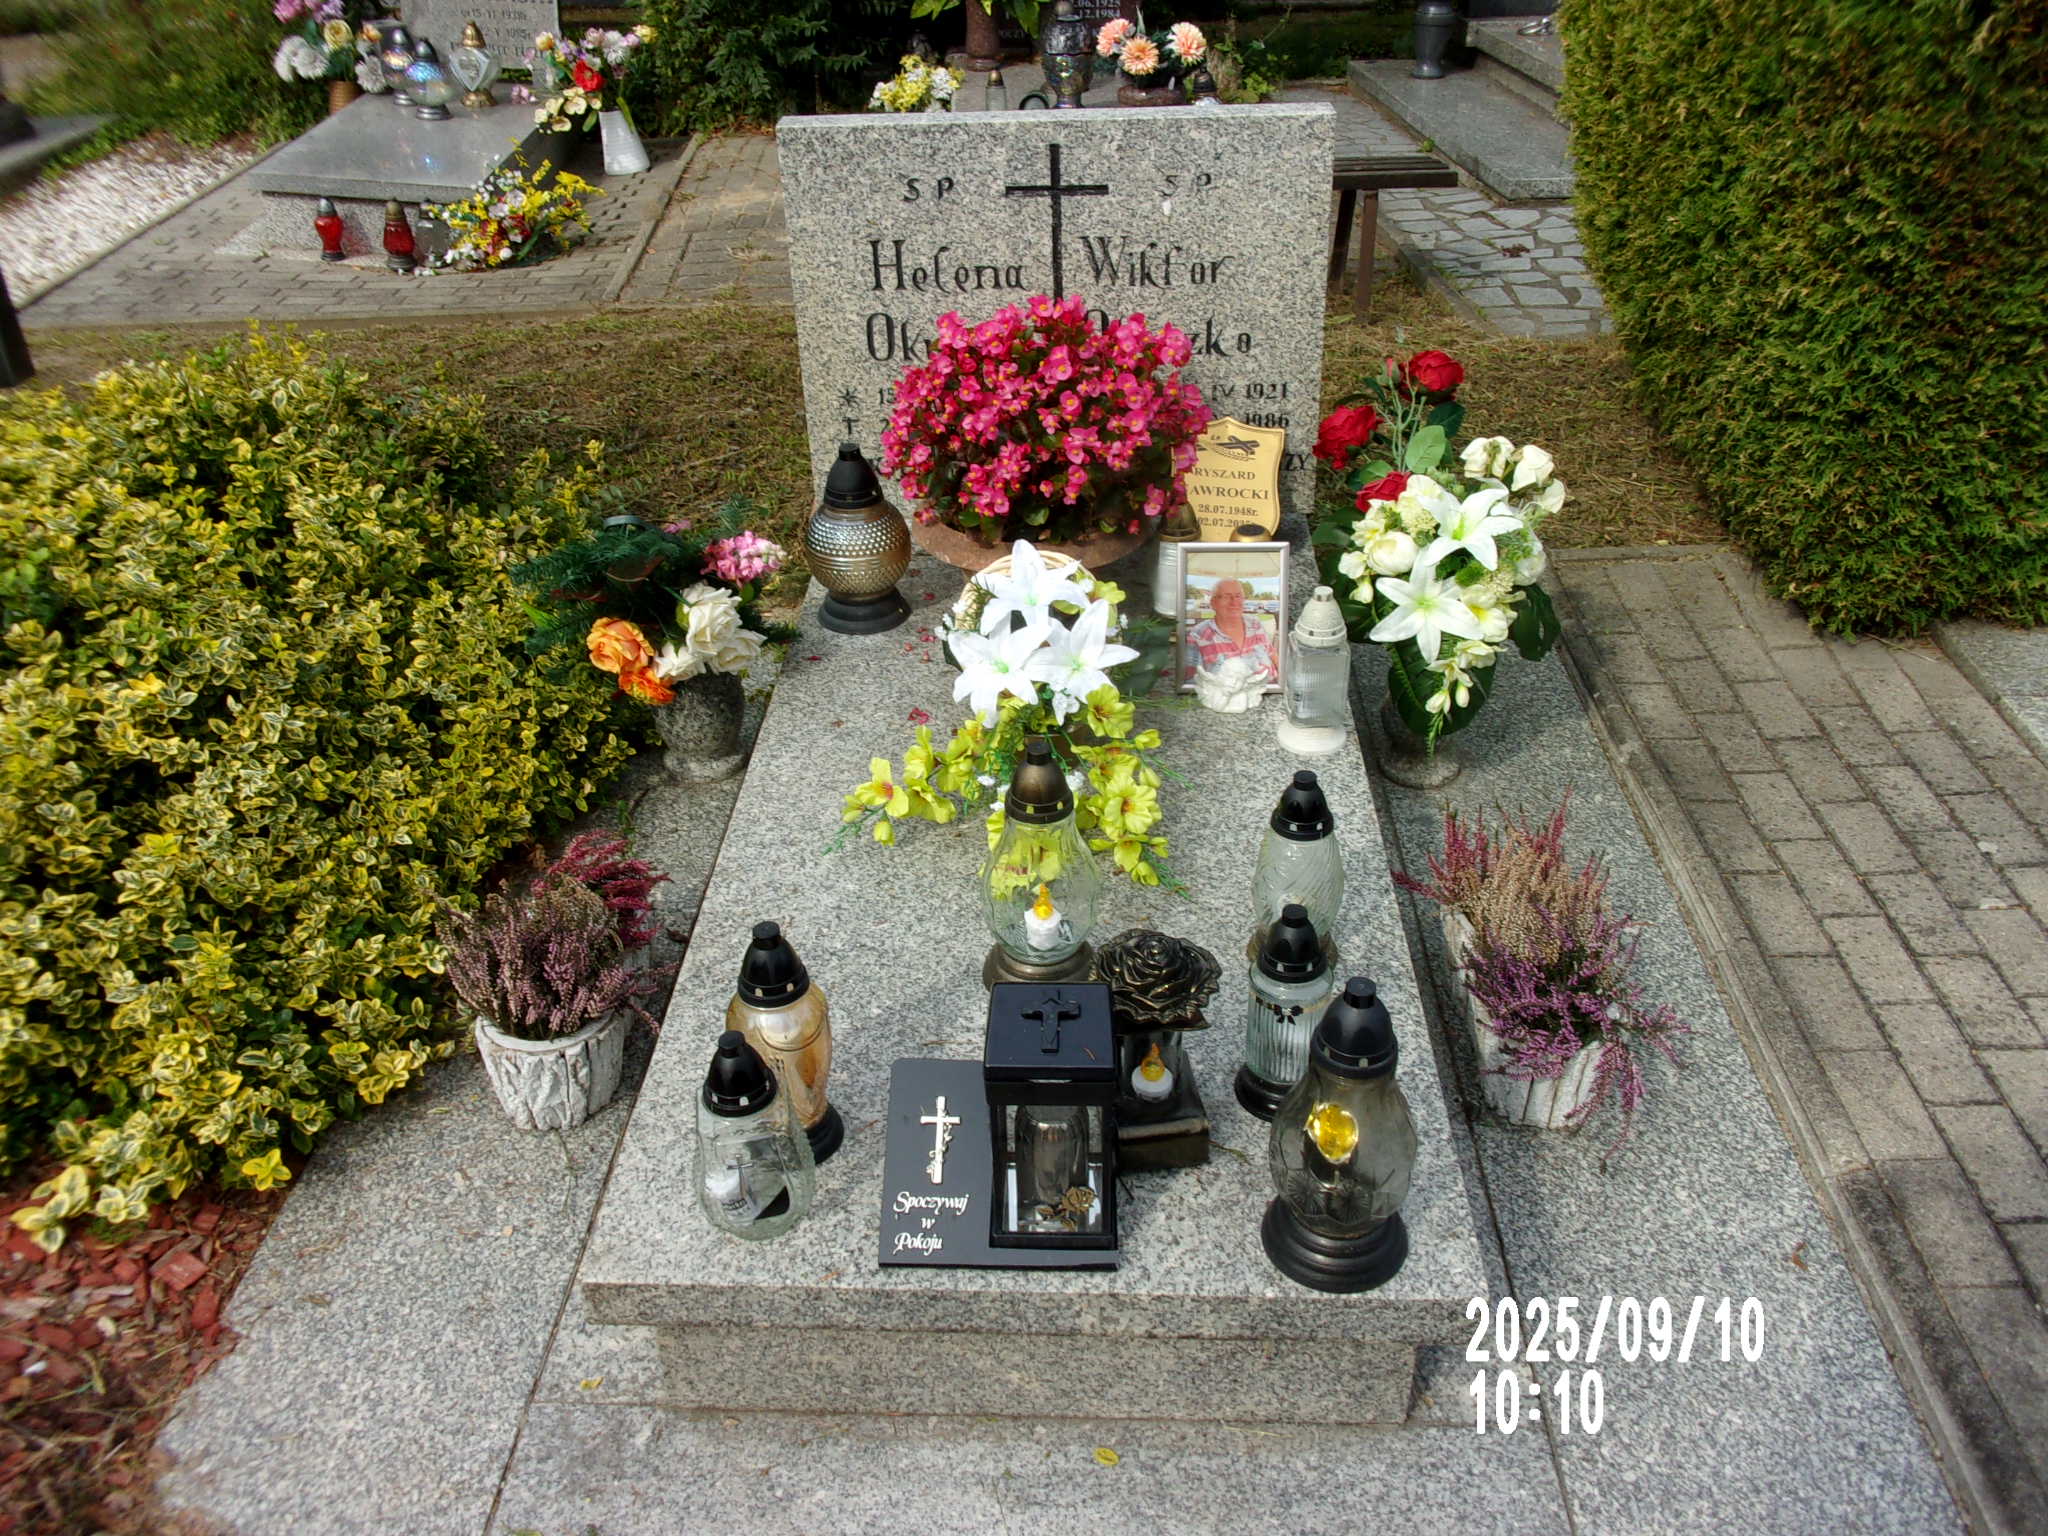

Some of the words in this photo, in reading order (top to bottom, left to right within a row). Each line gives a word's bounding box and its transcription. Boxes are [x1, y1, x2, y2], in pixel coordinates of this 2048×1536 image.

[868, 239, 1029, 294] Helena
[1079, 235, 1236, 290] Wiktor
[1245, 381, 1289, 400] 1921
[1194, 466, 1257, 481] RYSZARD
[1190, 484, 1270, 500] AWROCKI
[893, 1190, 970, 1216] Spoczywaj
[920, 1217, 936, 1230] w
[892, 1232, 943, 1257] Pokoju
